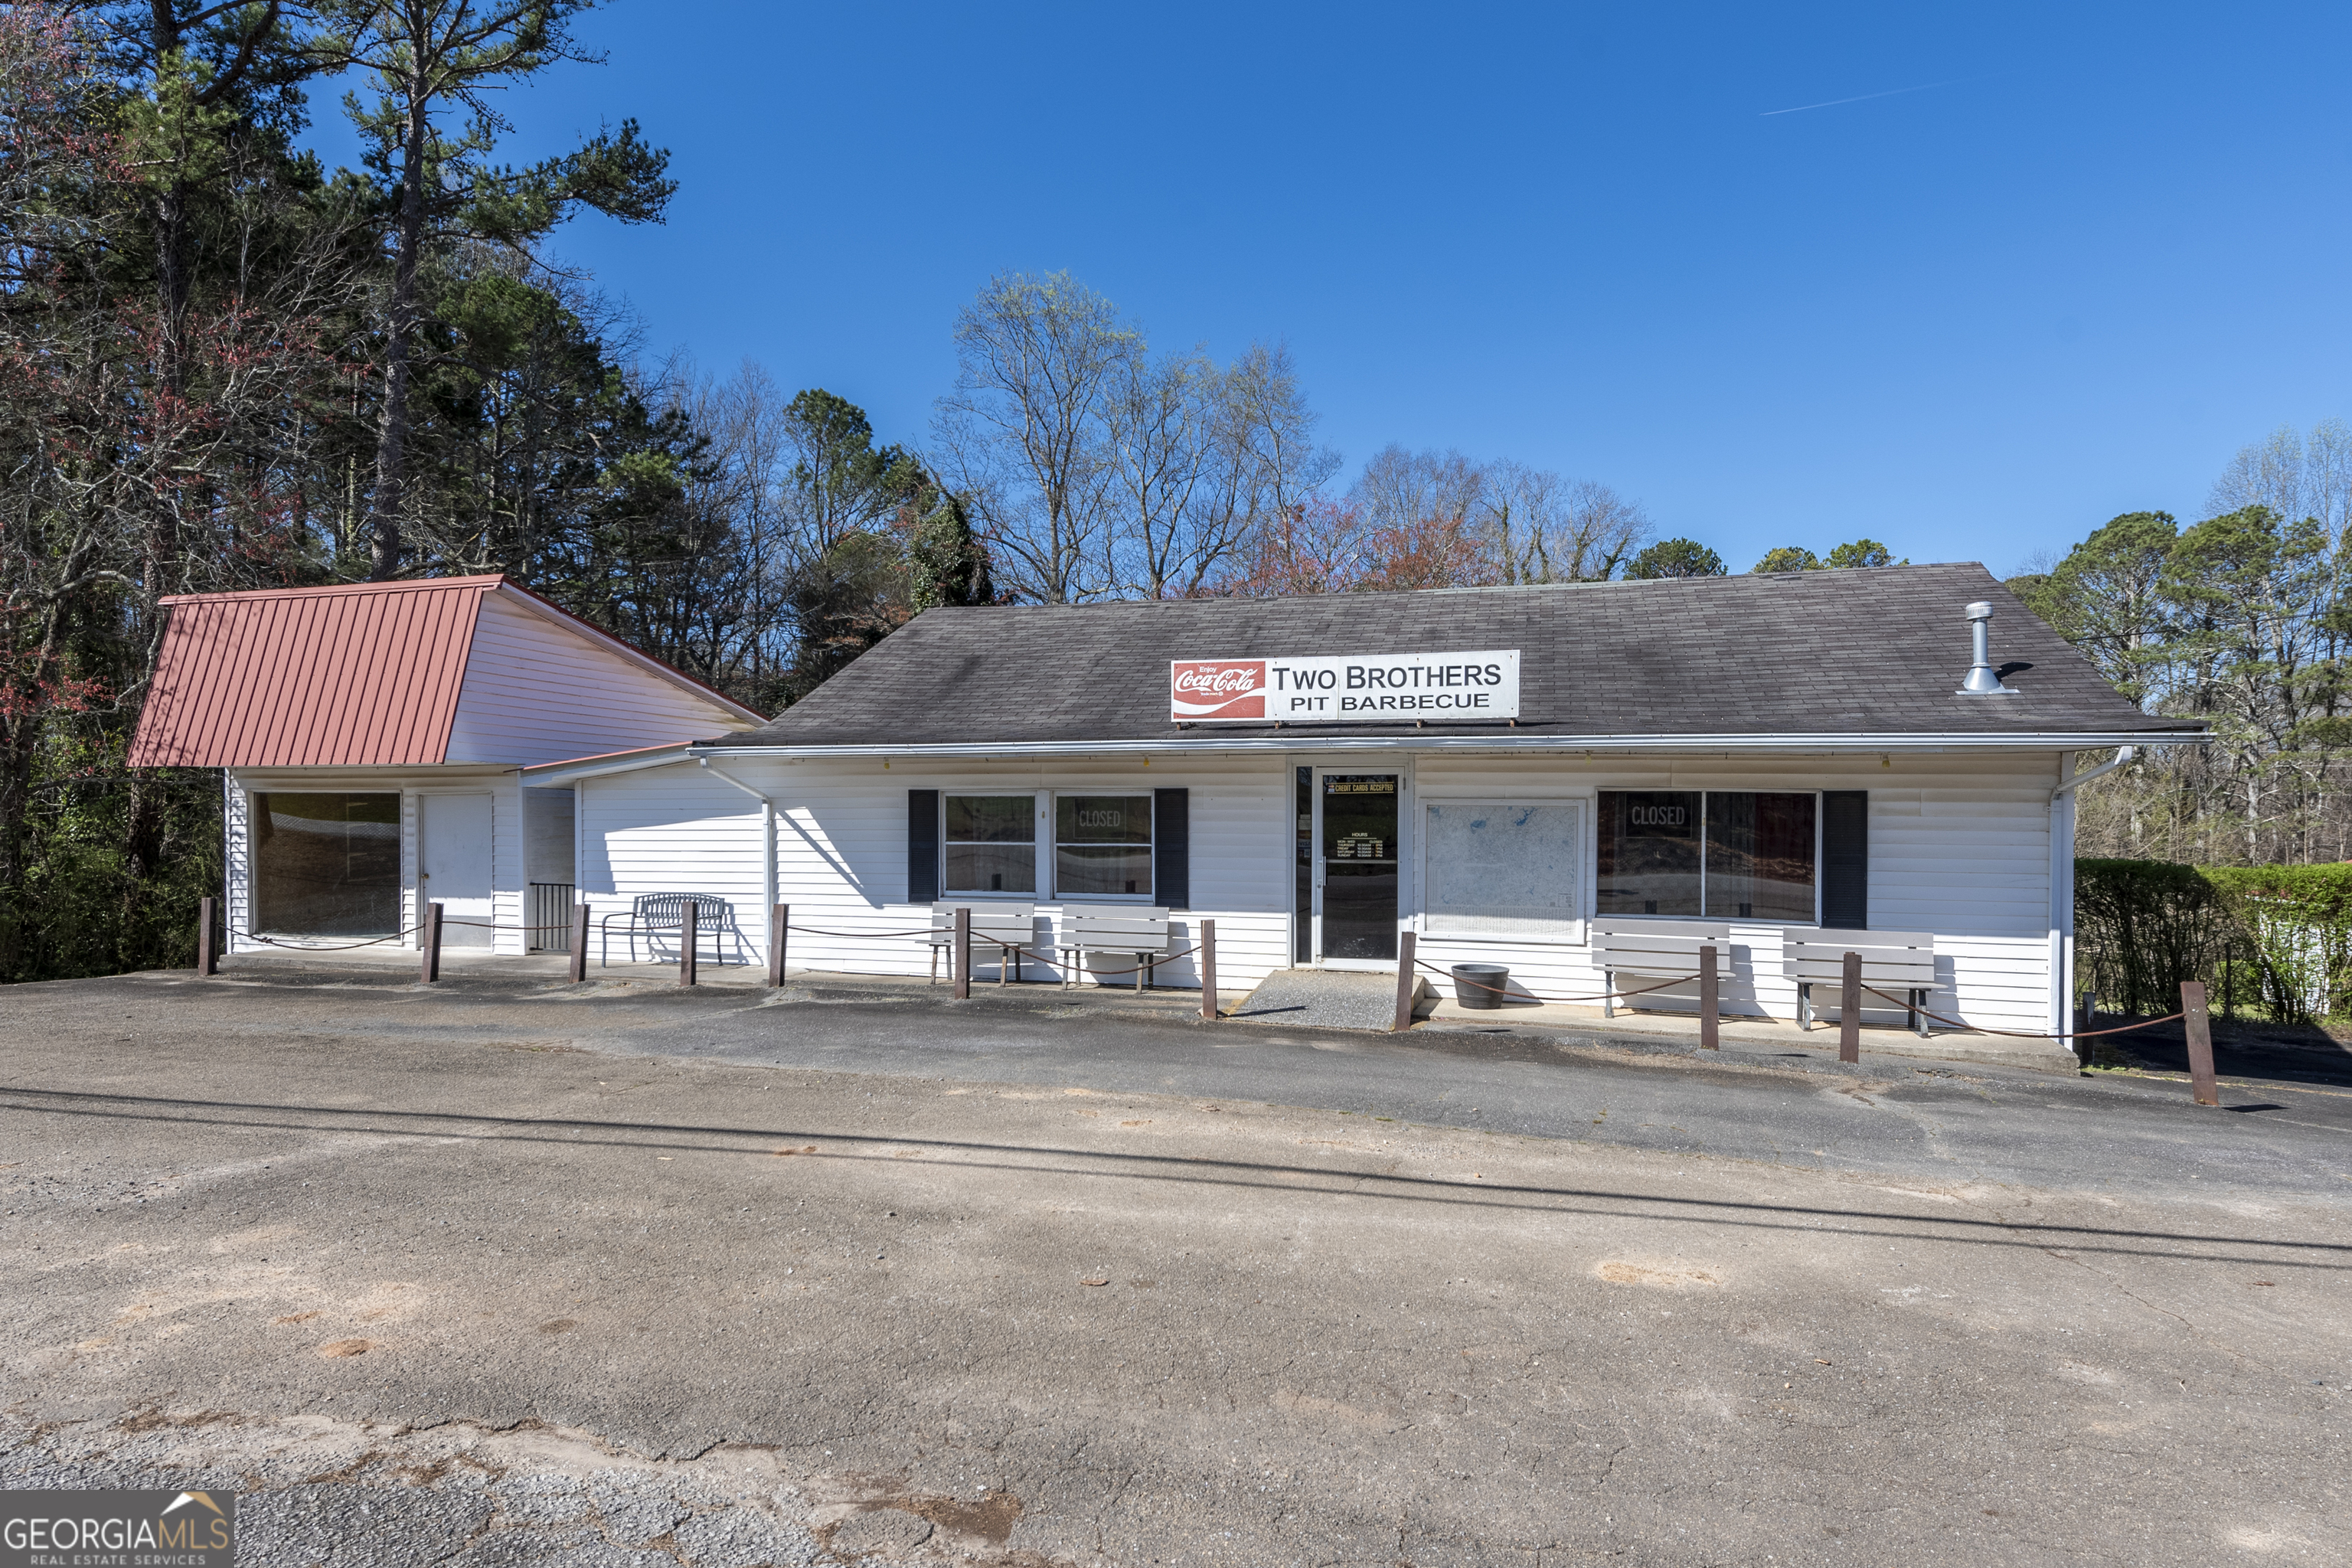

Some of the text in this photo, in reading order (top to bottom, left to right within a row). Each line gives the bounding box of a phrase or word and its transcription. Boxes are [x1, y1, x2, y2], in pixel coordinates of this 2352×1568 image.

[1175, 668, 1258, 692] Coca-Cola
[1272, 664, 1501, 690] TWO BROTHERS
[1291, 693, 1490, 711] PIT BARBECUE
[1080, 810, 1120, 827] CLOSED
[1632, 806, 1684, 825] CLOSED
